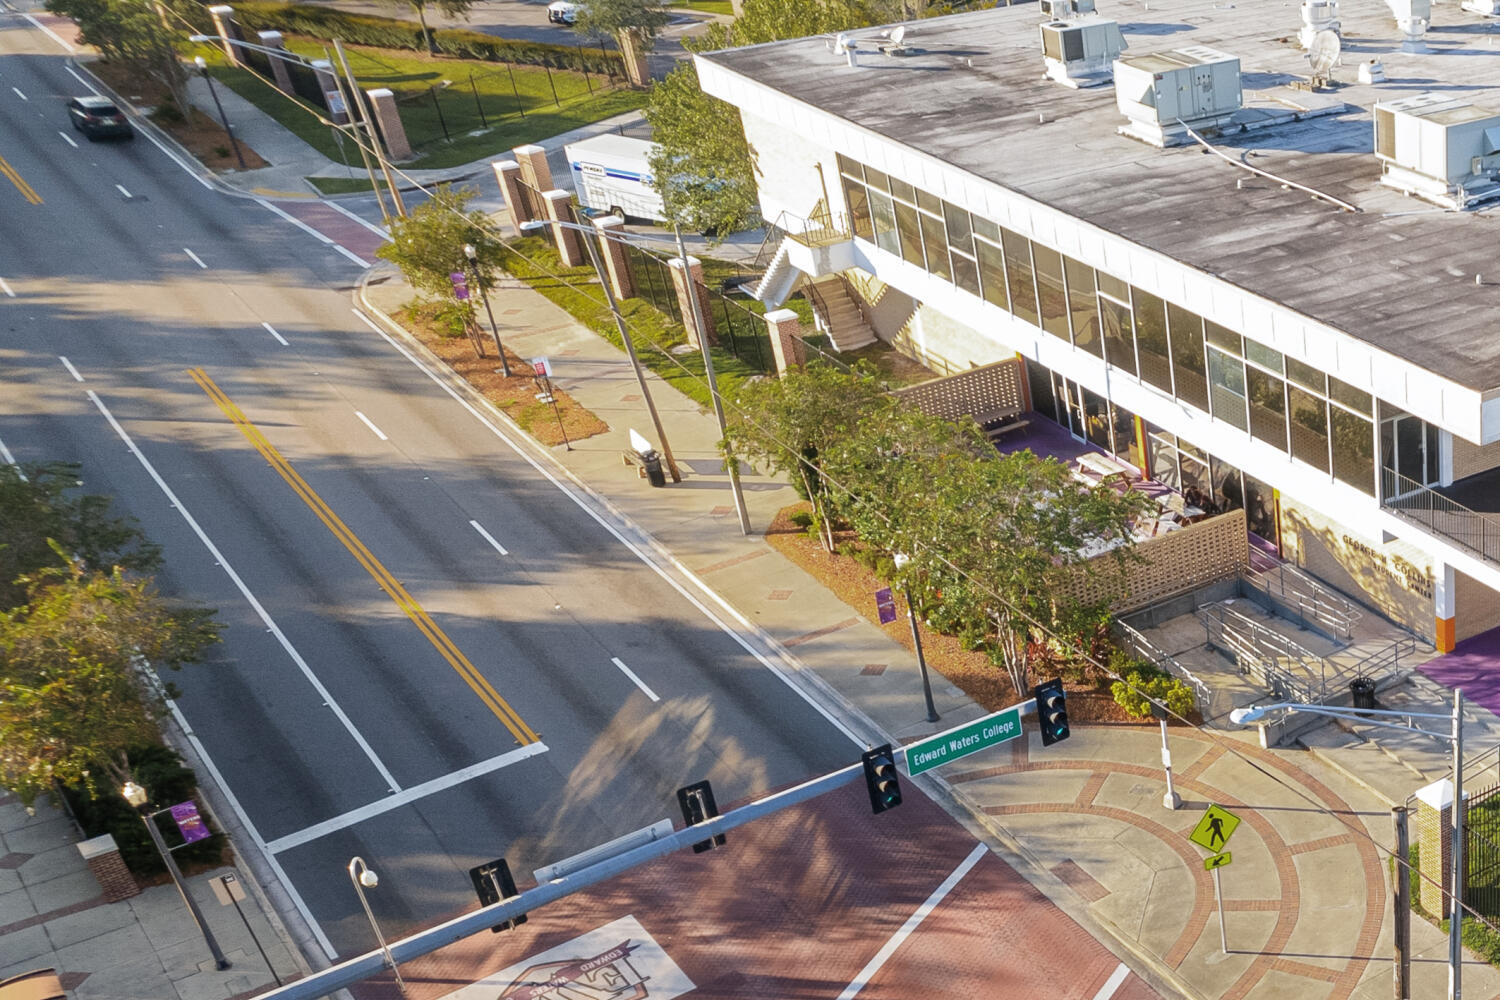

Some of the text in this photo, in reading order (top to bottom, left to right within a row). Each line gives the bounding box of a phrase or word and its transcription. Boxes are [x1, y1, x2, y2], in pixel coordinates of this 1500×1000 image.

[1342, 534, 1376, 556] GEORGE
[1394, 562, 1431, 588] COLLINS
[914, 721, 1014, 766] Edward Waters College
[580, 949, 623, 972] EDWARD
[530, 975, 570, 997] WATERS
